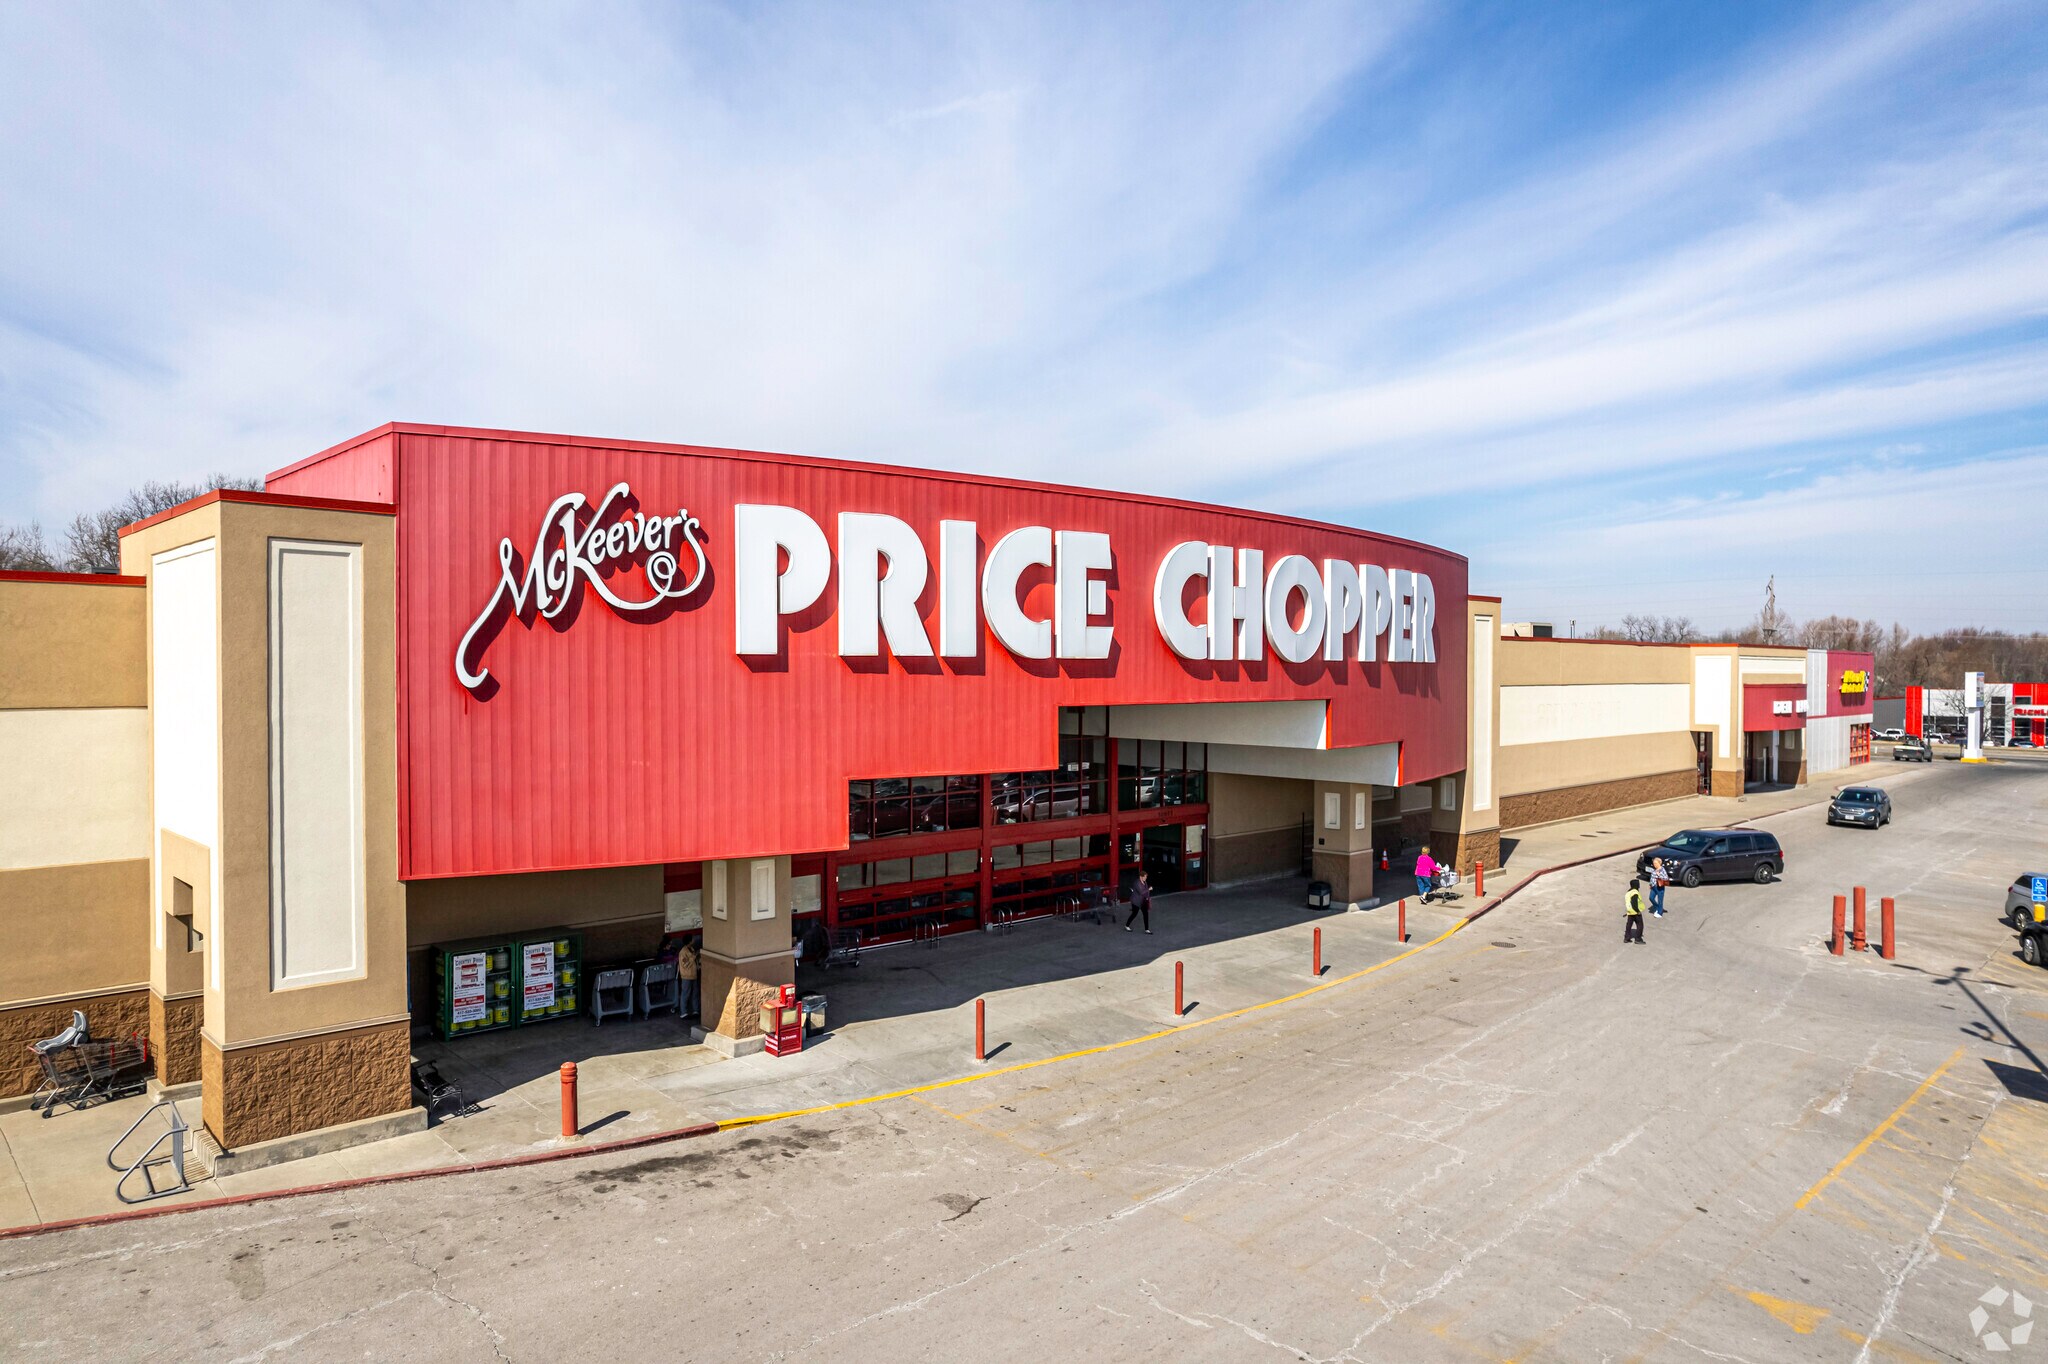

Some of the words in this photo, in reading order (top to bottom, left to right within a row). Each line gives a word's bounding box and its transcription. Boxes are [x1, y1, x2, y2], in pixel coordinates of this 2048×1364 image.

[455, 482, 706, 689] McKeever's
[734, 503, 1118, 660] PRICE
[1153, 540, 1437, 663] CHOPPER
[2014, 708, 2048, 716] RICHL
